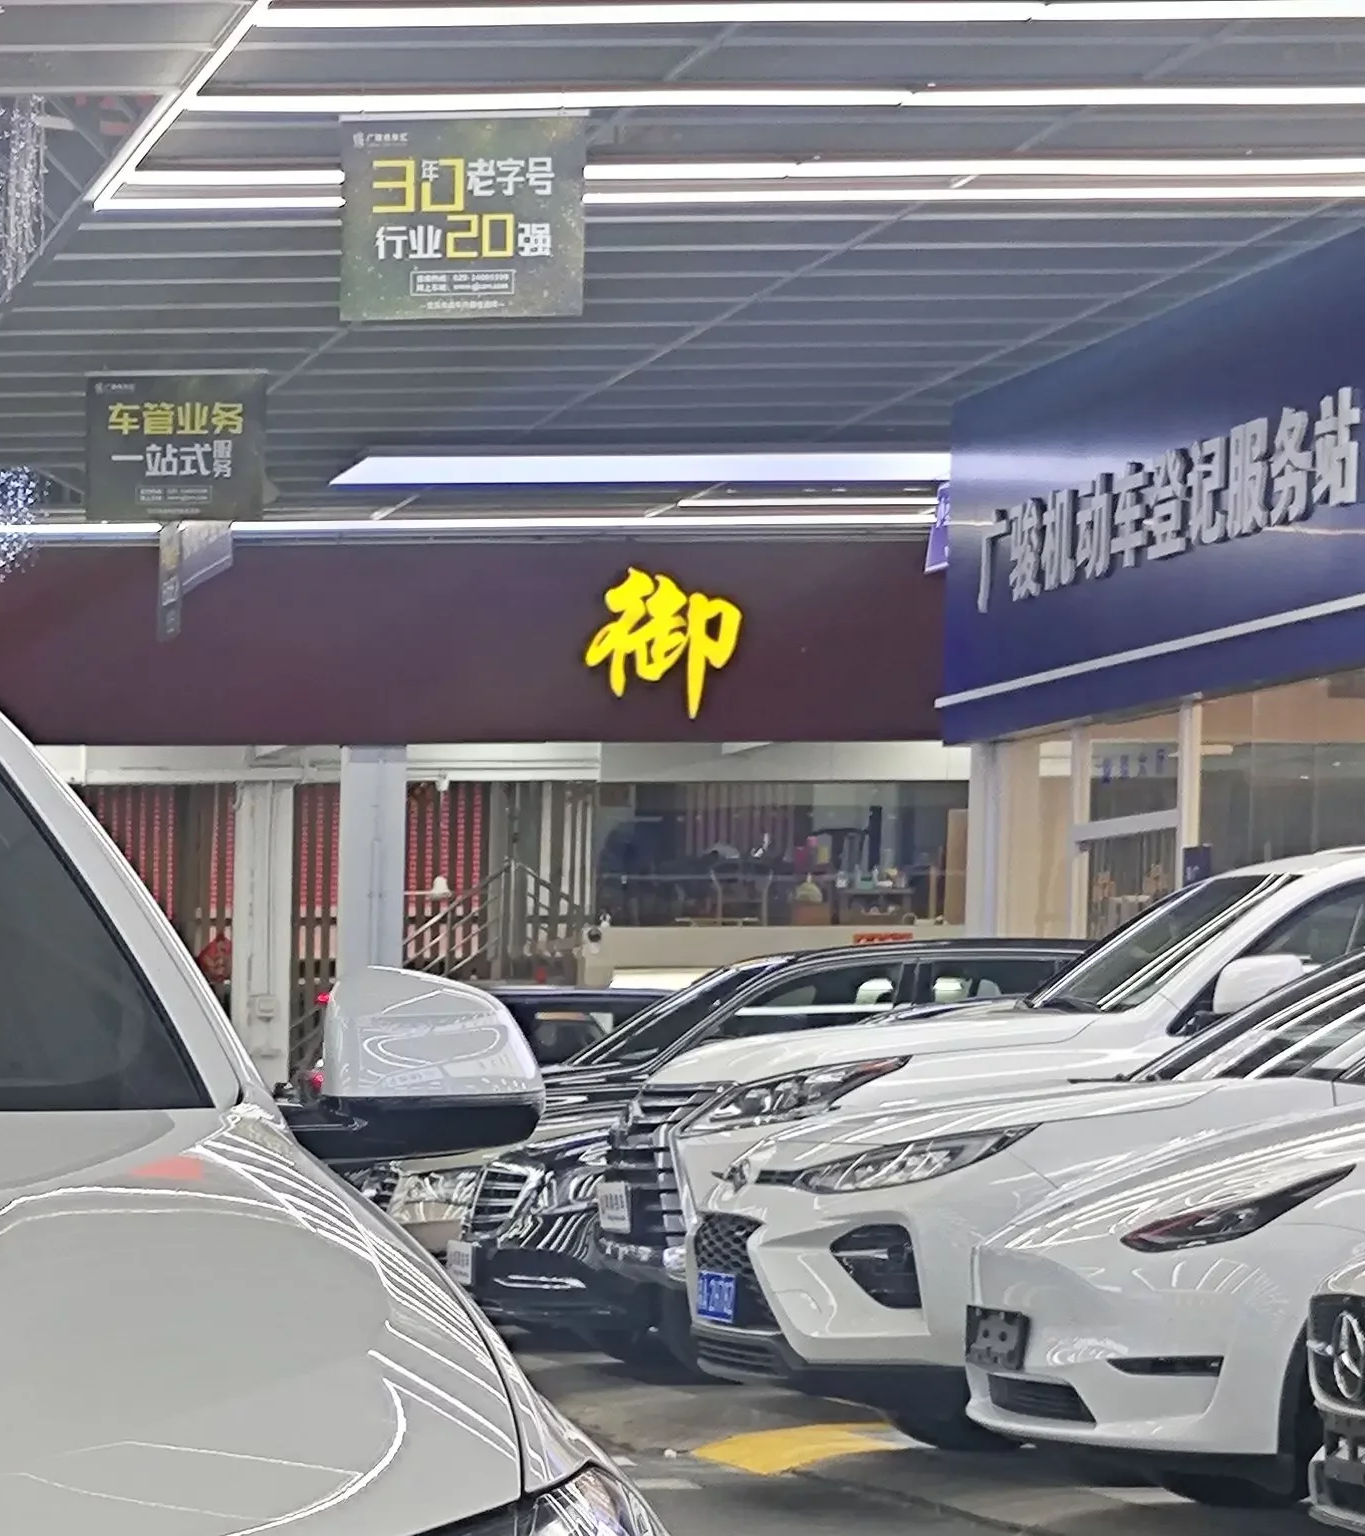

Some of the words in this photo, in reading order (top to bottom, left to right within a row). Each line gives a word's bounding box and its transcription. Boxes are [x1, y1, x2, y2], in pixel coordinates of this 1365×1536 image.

[374, 212, 553, 260] 行业20强
[107, 401, 245, 436] 车管业务
[976, 385, 1362, 614] 广骏机动车登记服务站
[584, 565, 745, 720] 御
